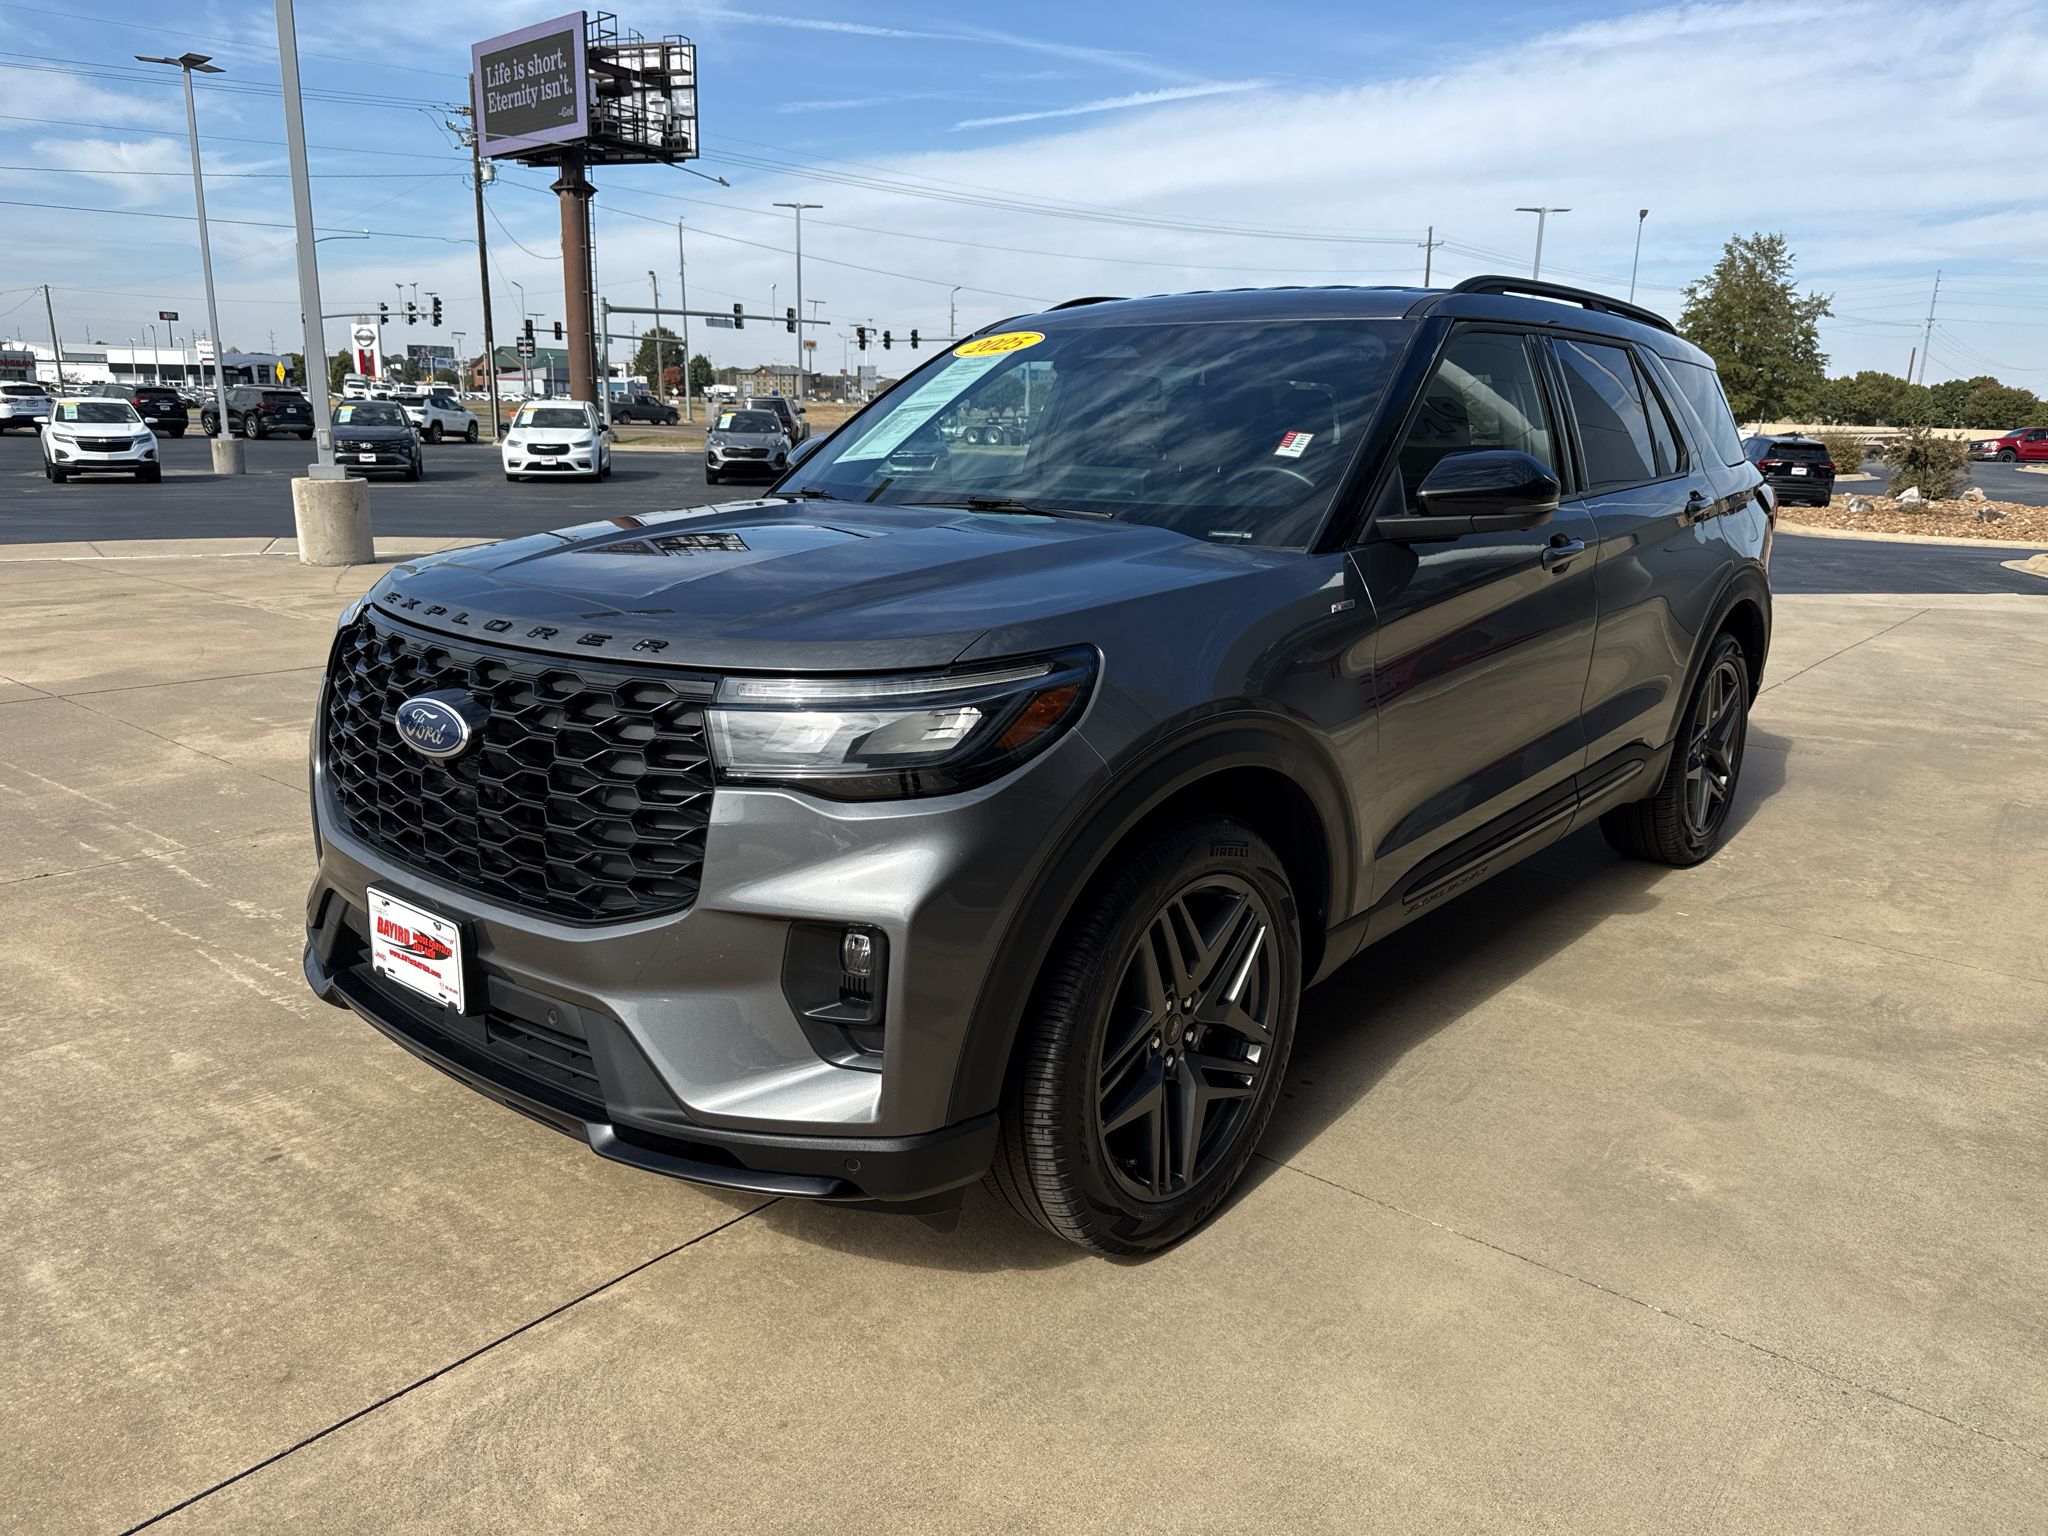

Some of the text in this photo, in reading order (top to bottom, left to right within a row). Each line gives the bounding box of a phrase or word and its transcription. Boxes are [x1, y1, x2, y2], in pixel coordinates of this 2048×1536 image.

[486, 48, 567, 88] Life is short.
[487, 74, 573, 114] Eternity isn't.
[962, 336, 1035, 354] 2025
[383, 591, 670, 653] EXPLORER
[406, 707, 446, 746] Ford
[1209, 840, 1249, 858] PIRELLI
[376, 916, 410, 946] BAYIRD
